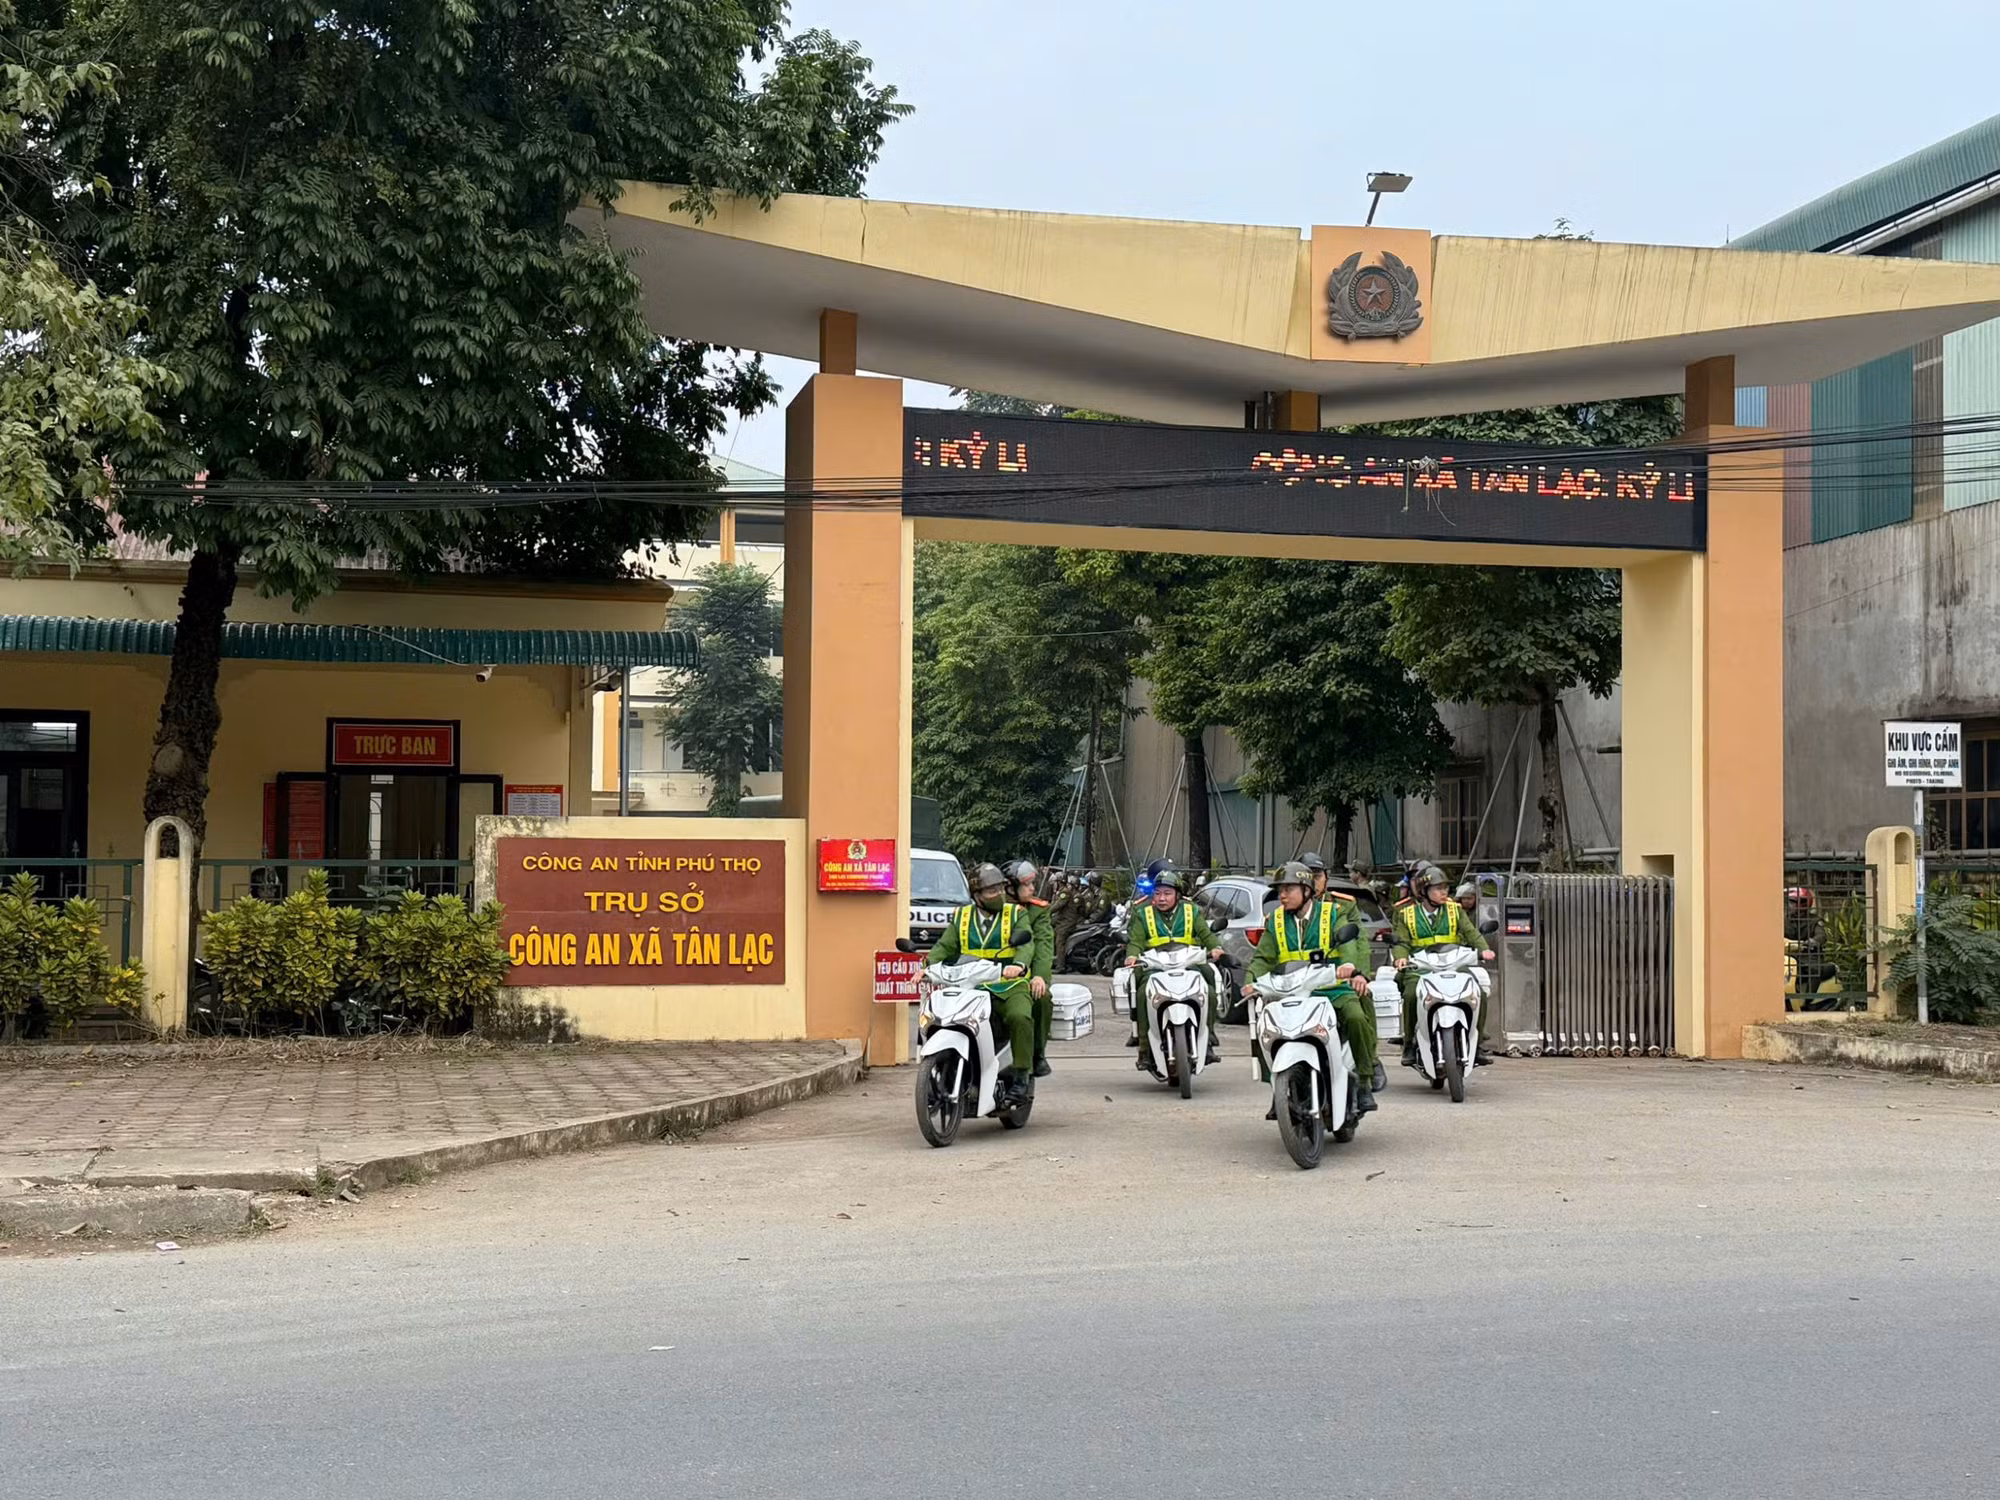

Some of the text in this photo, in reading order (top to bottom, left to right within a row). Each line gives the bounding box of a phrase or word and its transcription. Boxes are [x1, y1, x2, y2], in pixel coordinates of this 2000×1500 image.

[353, 733, 436, 758] TRỰC BAN
[1888, 726, 1958, 756] KHU VỰC CẤM
[522, 851, 762, 875] CÔNG AN TỈNH PHÚ THỌ
[584, 881, 705, 918] TRỤ SỞ
[509, 925, 774, 972] CÔNG AN XÃ TÂN LẠC
